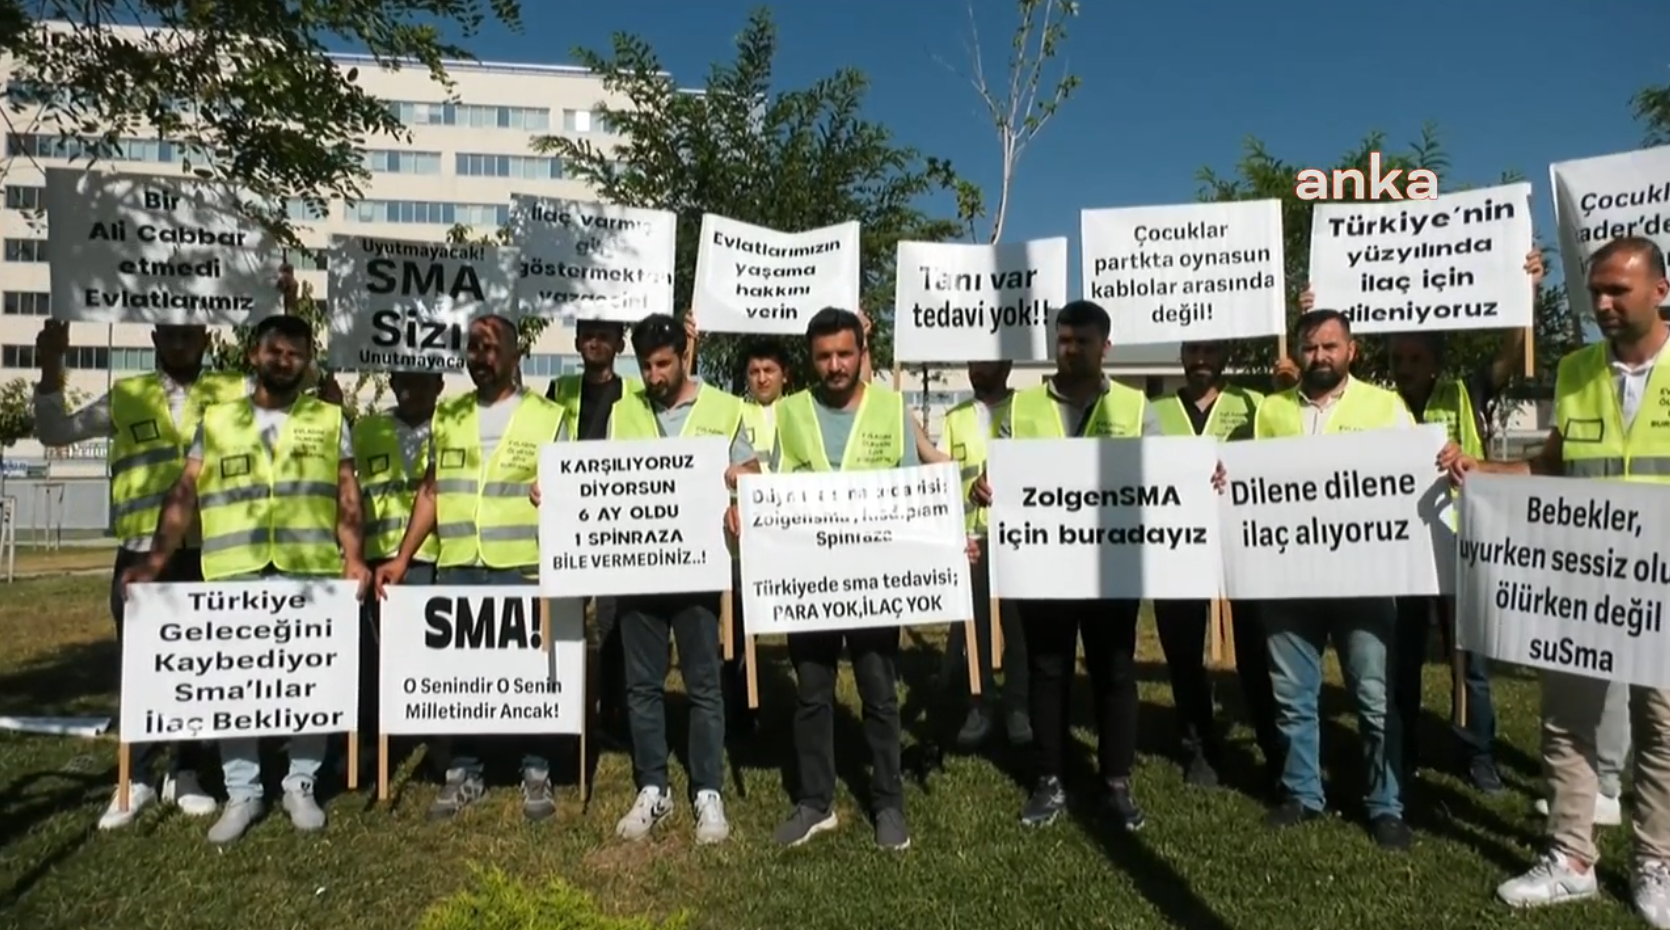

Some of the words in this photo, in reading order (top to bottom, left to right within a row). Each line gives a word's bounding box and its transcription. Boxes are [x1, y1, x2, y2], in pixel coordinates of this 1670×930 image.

[145, 191, 179, 210] Bir
[1581, 182, 1670, 218] Çocukl
[1328, 198, 1515, 238] Türkiye'nin
[88, 221, 125, 242] Ali
[137, 224, 246, 246] Cabbar
[713, 231, 840, 258] Evlatlarımızın
[1134, 222, 1229, 247] Çocuklar
[362, 238, 485, 260] Uyutmayacak!
[1347, 238, 1493, 268] yüzyılında
[119, 259, 220, 278] etmedi
[735, 261, 816, 280] yaşama
[1095, 250, 1173, 276] partkta
[1179, 248, 1270, 271] oynasun
[366, 259, 485, 302] SMA
[736, 284, 810, 298] hakkını
[920, 266, 981, 291] Tanı
[991, 268, 1037, 290] var
[1091, 277, 1177, 298] kablolar
[1183, 271, 1275, 293] arasında
[1361, 274, 1411, 295] ilaç
[1422, 269, 1475, 293] için
[85, 289, 253, 311] Evlatlarımız
[746, 303, 798, 320] verin
[1343, 300, 1498, 324] dileniyoruz
[913, 301, 984, 328] tedavi
[990, 299, 1049, 334] yok!!
[1152, 303, 1213, 327] değil!
[360, 349, 465, 369] Unutmayaca
[560, 455, 694, 475] KARŞILIYORUZ
[580, 480, 675, 497] DİYORSUN
[1022, 486, 1181, 512] ZolgenSMA
[1231, 477, 1317, 506] Dilene
[1325, 469, 1416, 499] dilene
[578, 509, 589, 521] 6
[597, 507, 621, 521] AY
[630, 505, 679, 520] OLDU
[1527, 496, 1642, 538] Bebekler,
[575, 533, 581, 546] 1
[588, 528, 683, 546] SPİNRAZA
[999, 521, 1048, 550] için
[1059, 524, 1207, 550] buradayız
[1243, 519, 1289, 554] ilaç
[1296, 516, 1409, 551] alıyoruz
[553, 552, 587, 570] BİLE
[591, 548, 706, 568] VERMEDİNİZ..!
[1460, 537, 1546, 569] uyurken
[1551, 548, 1628, 579] sessiz
[753, 576, 839, 599] Türkiyede
[843, 576, 878, 592] sma
[883, 568, 958, 590] tedavisi;
[188, 591, 306, 614] Türkiye
[774, 603, 819, 621] PARA
[906, 595, 943, 613] YOK
[1496, 580, 1588, 621] ölürken
[1594, 594, 1661, 637] değil
[160, 619, 332, 643] Geleceğini
[424, 596, 542, 650] SMA!
[154, 650, 337, 676] Kaybediyor
[1529, 638, 1613, 672] suSma
[175, 679, 316, 702] Sma'lılar
[404, 678, 416, 694] O
[421, 677, 493, 694] Senindir
[497, 678, 510, 694] O
[514, 677, 562, 694] Senin
[146, 710, 203, 736] İlaç
[213, 708, 344, 732] Bekliyor
[406, 702, 497, 720] Milletindir
[500, 702, 559, 719] Ancak!
